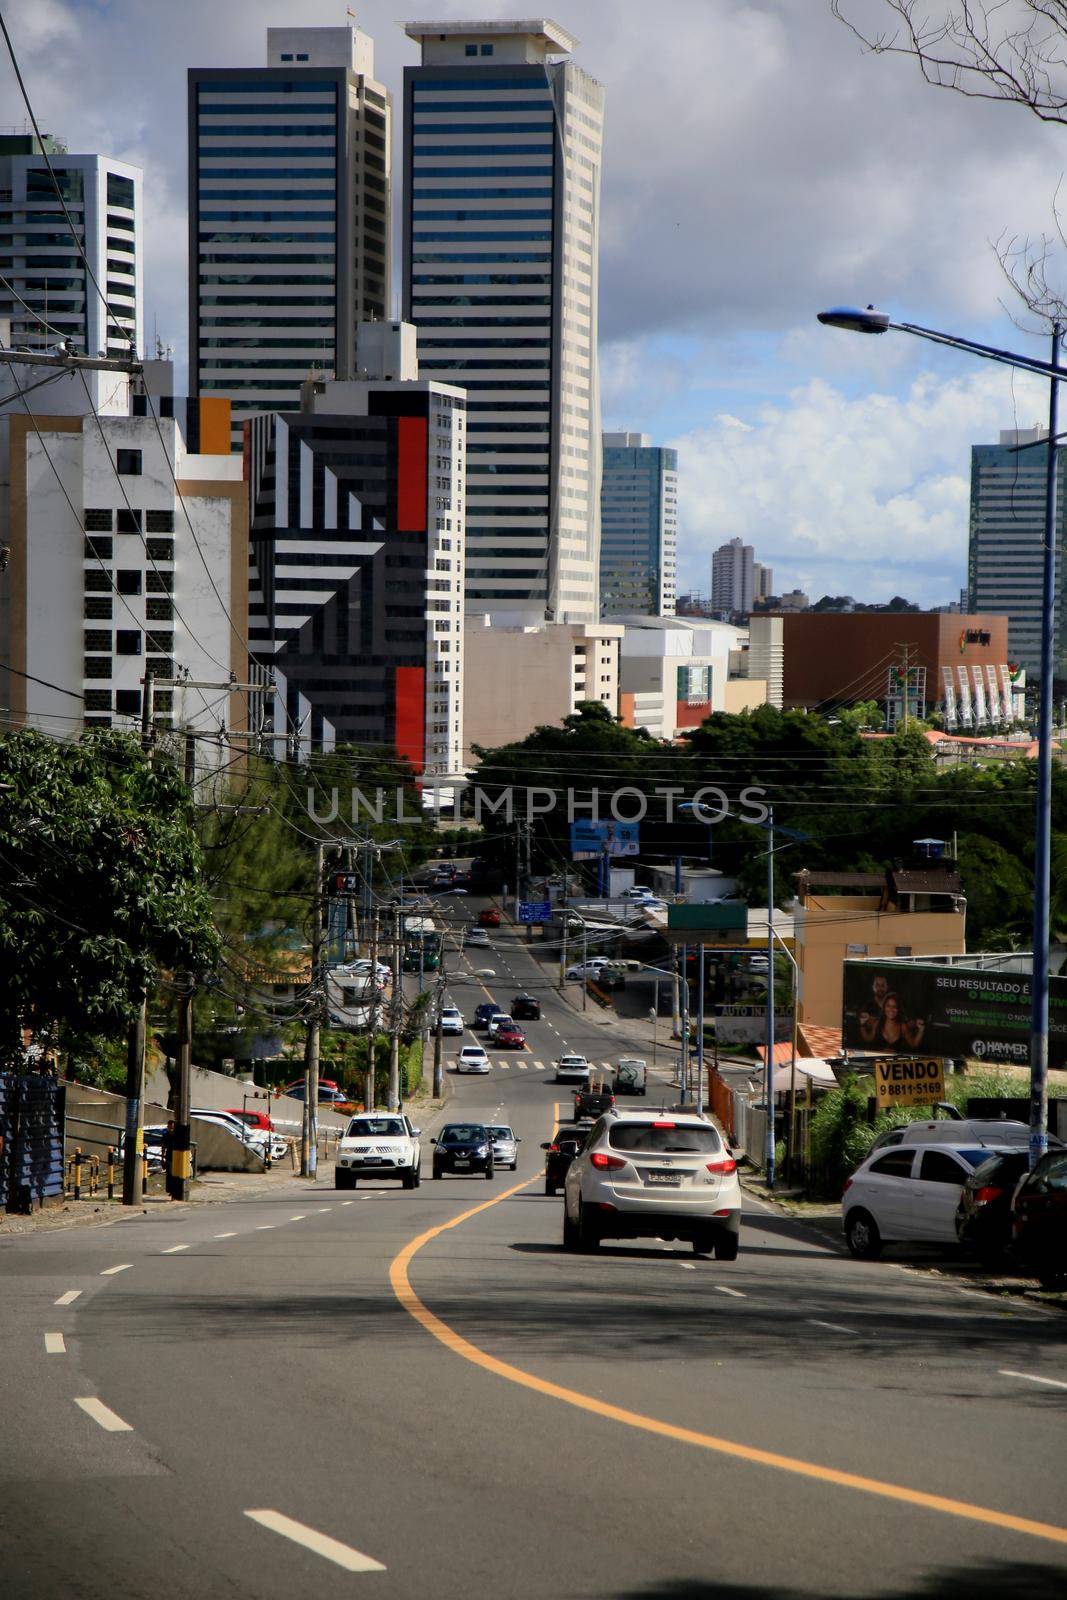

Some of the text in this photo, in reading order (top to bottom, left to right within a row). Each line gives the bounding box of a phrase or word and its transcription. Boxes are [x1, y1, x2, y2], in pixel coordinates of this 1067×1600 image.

[936, 978, 1030, 994] SEU RESULTADO É
[968, 991, 977, 1000] O
[980, 992, 1017, 1003] NOSSO
[721, 1006, 748, 1017] AUTO
[945, 1008, 969, 1016] VENHA
[986, 1041, 1028, 1055] HAMMER
[879, 1062, 939, 1080] VENDO
[880, 1085, 886, 1096] 9
